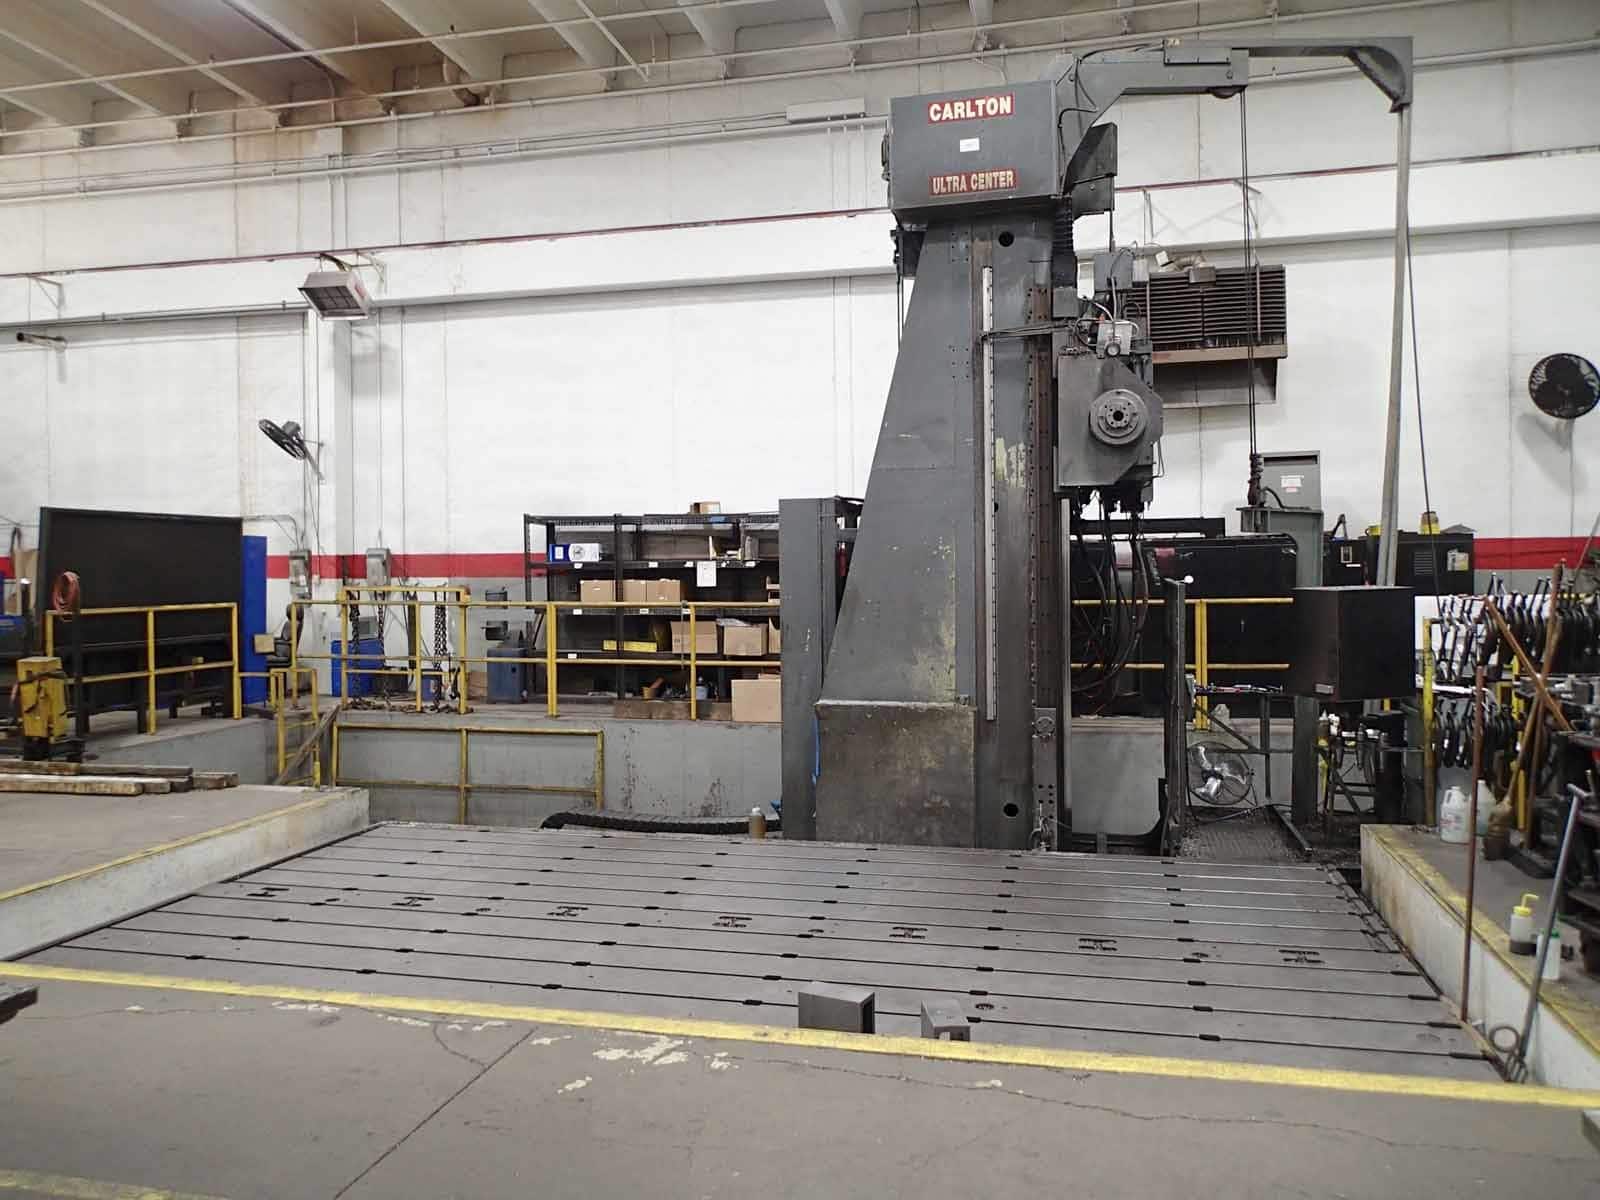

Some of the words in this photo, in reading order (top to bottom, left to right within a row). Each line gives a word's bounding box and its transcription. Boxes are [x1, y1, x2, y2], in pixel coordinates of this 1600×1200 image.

[929, 96, 1011, 121] CARLTON
[932, 175, 967, 194] ULTRA
[971, 170, 1014, 191] CENTER
